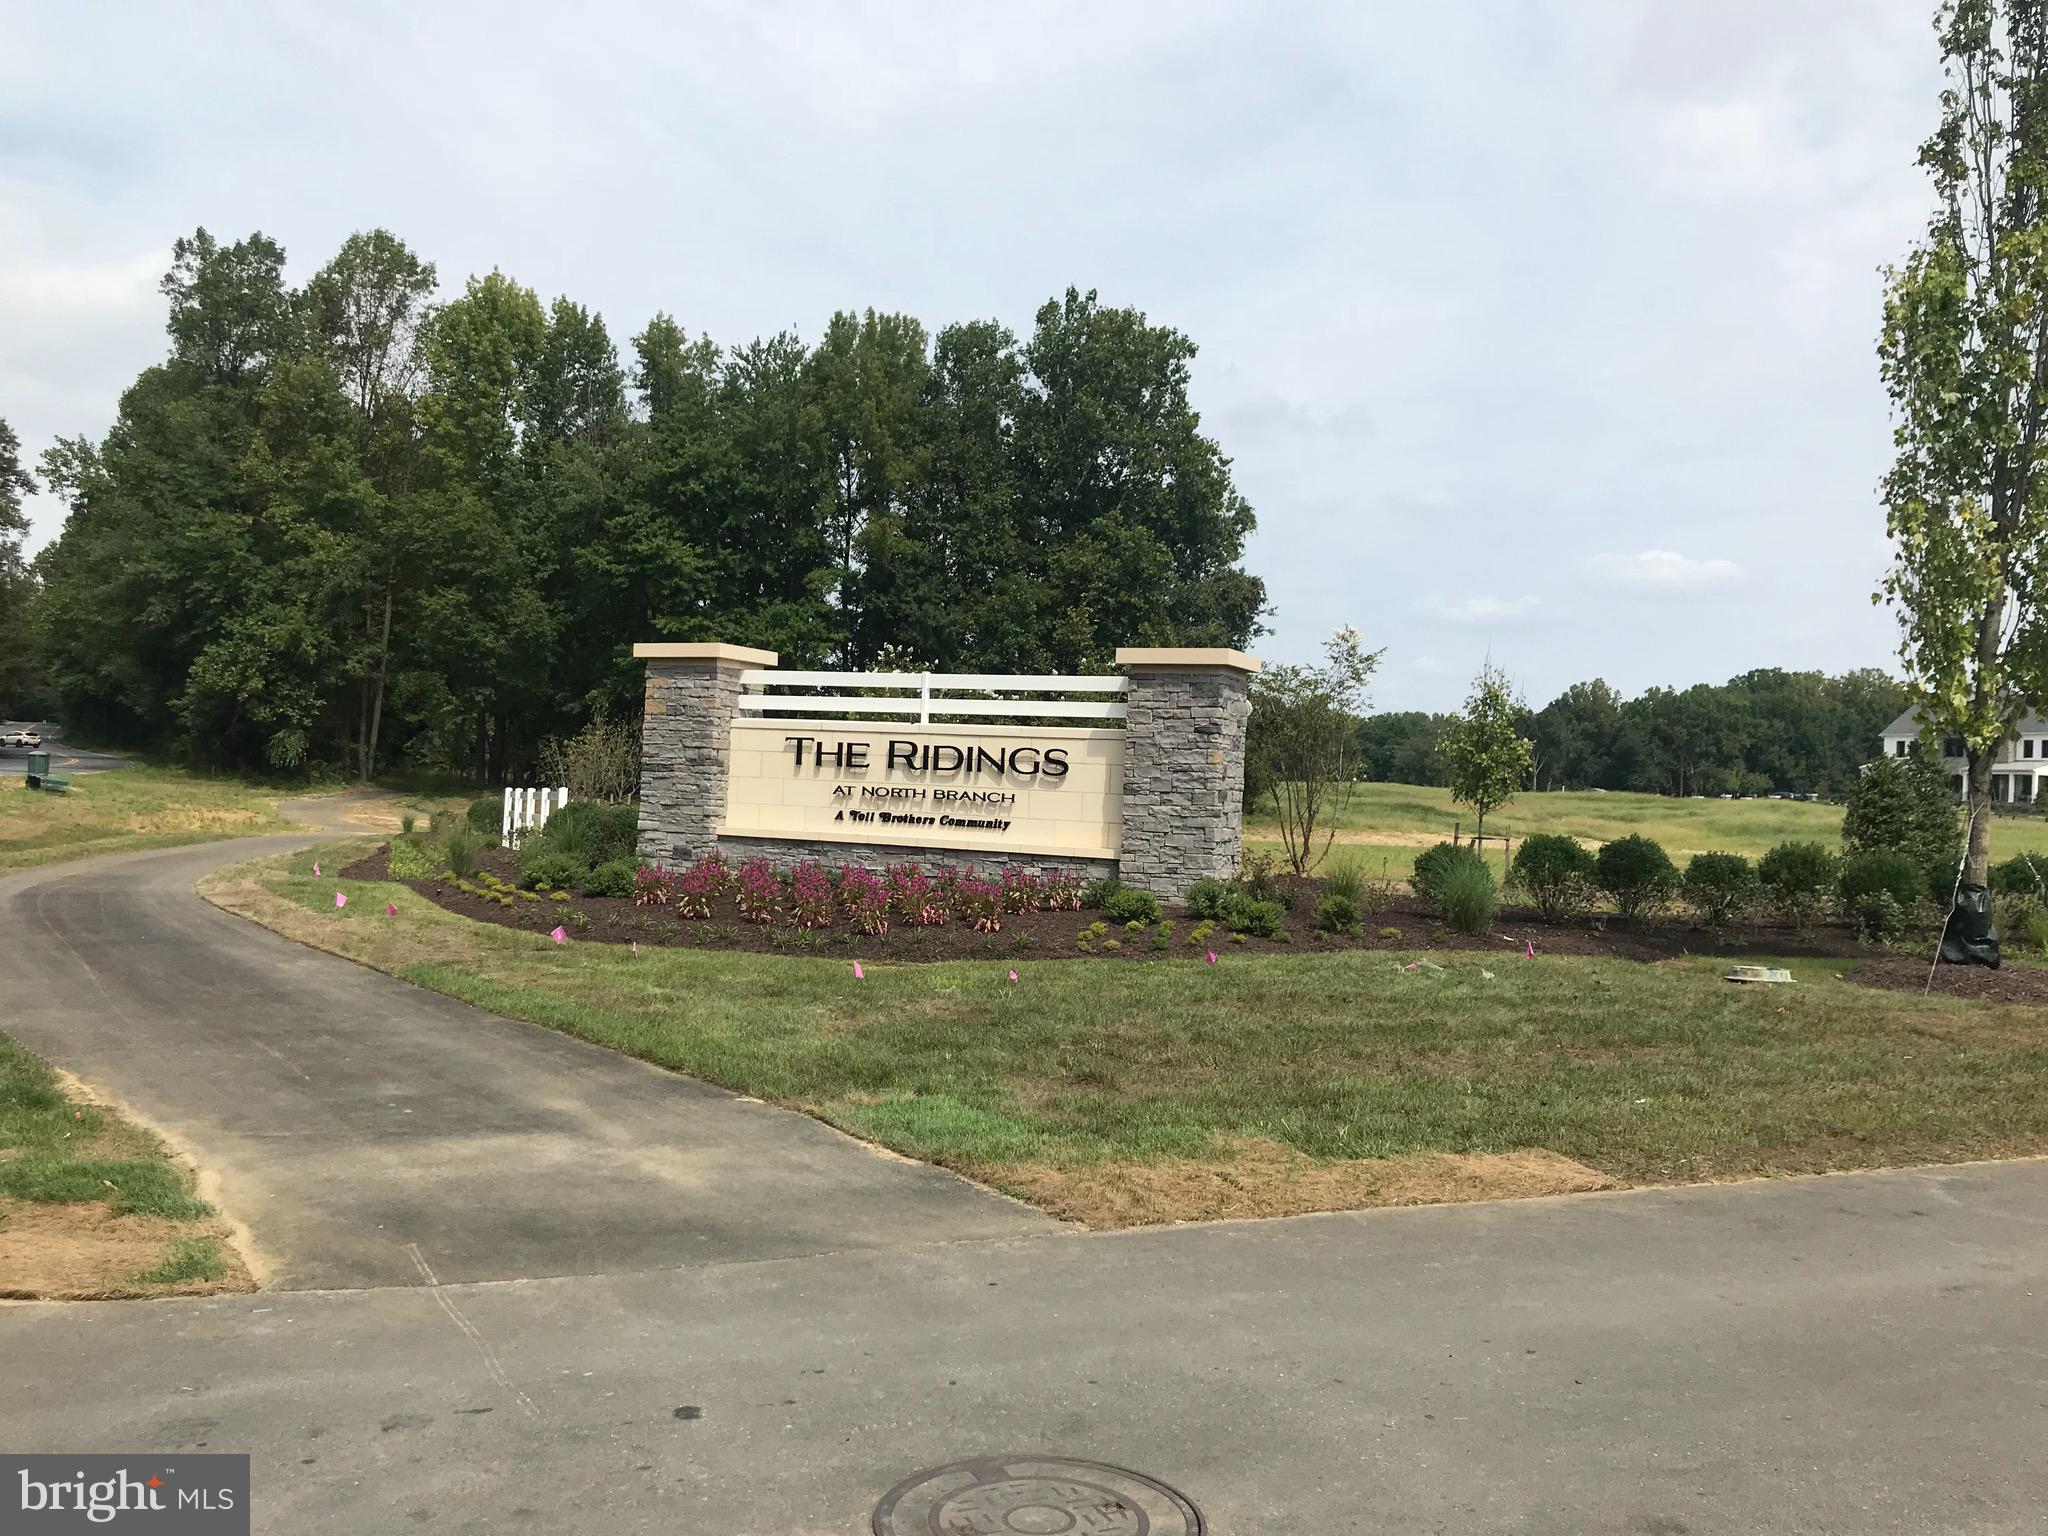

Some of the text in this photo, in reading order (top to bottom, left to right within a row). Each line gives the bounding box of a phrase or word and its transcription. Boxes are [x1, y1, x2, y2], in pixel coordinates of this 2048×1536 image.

[785, 736, 1070, 777] THE RIDINGS
[832, 785, 1016, 804] AT NORTH BRANCH
[834, 809, 1011, 831] A Toll Brothers Community
